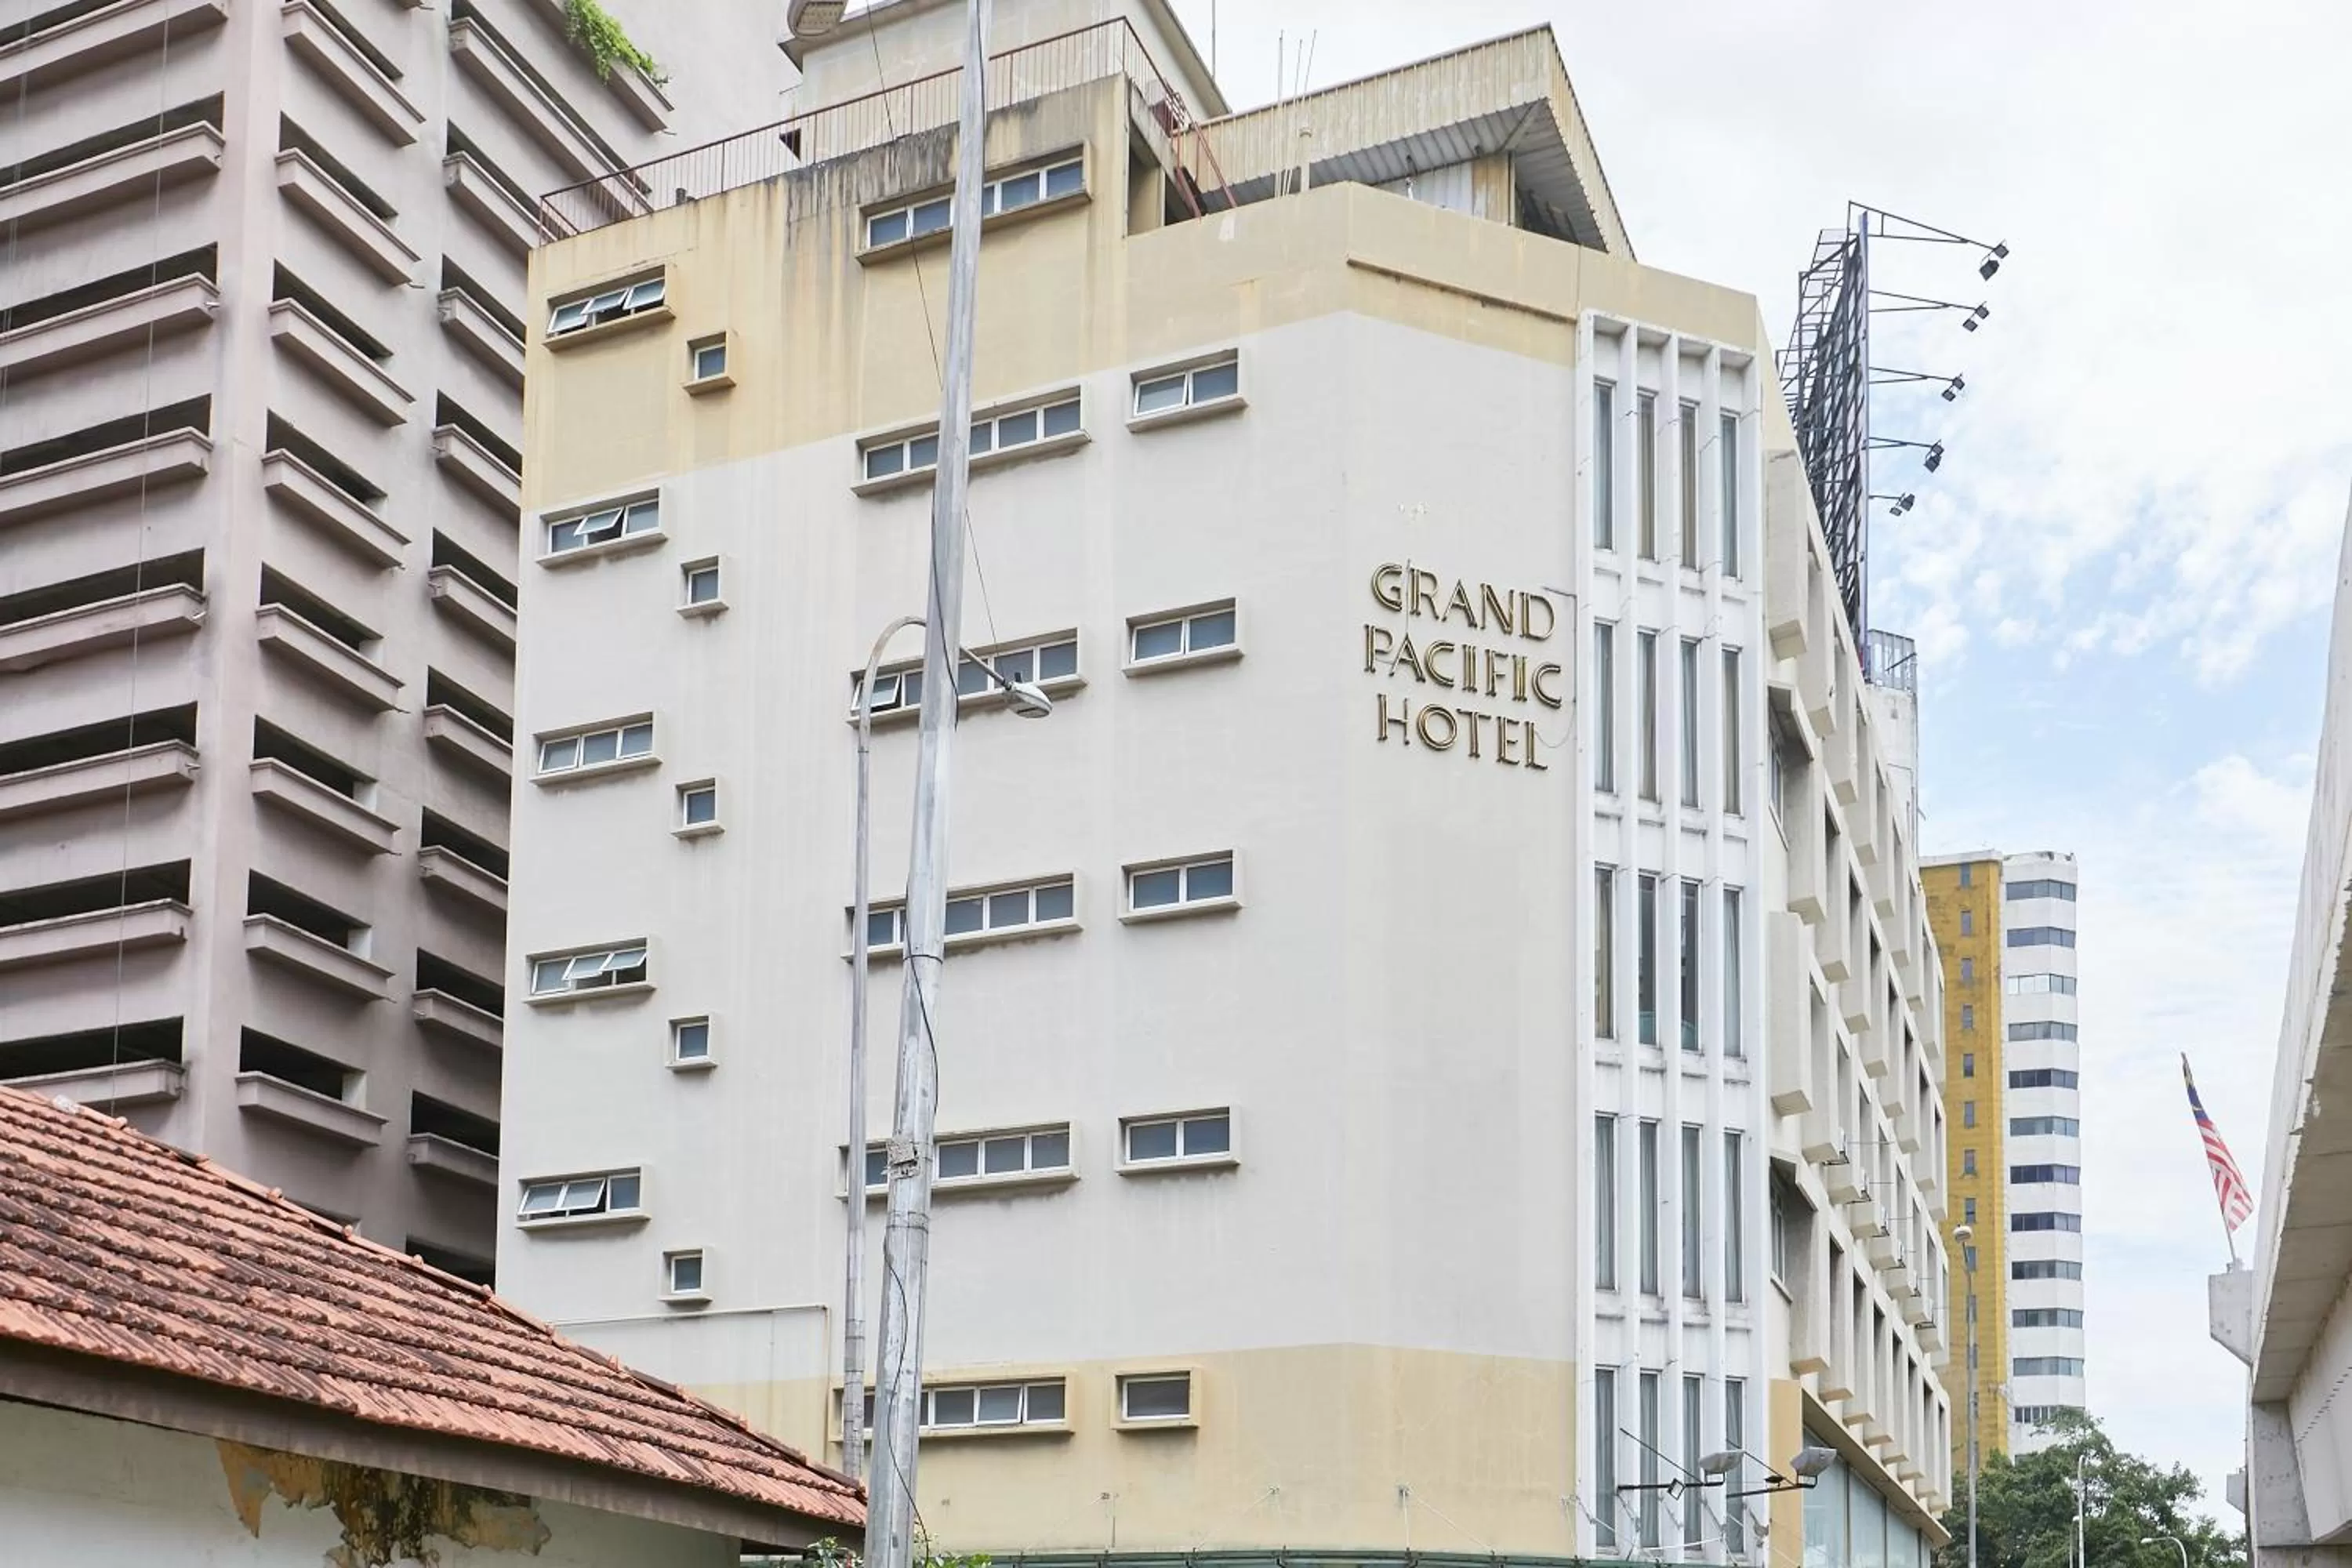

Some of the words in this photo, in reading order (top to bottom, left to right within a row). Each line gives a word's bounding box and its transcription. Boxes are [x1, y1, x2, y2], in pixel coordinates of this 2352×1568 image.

[1370, 563, 1555, 641] GRAND
[1363, 624, 1563, 709] PACIFIC
[1377, 693, 1548, 770] HOTEL
